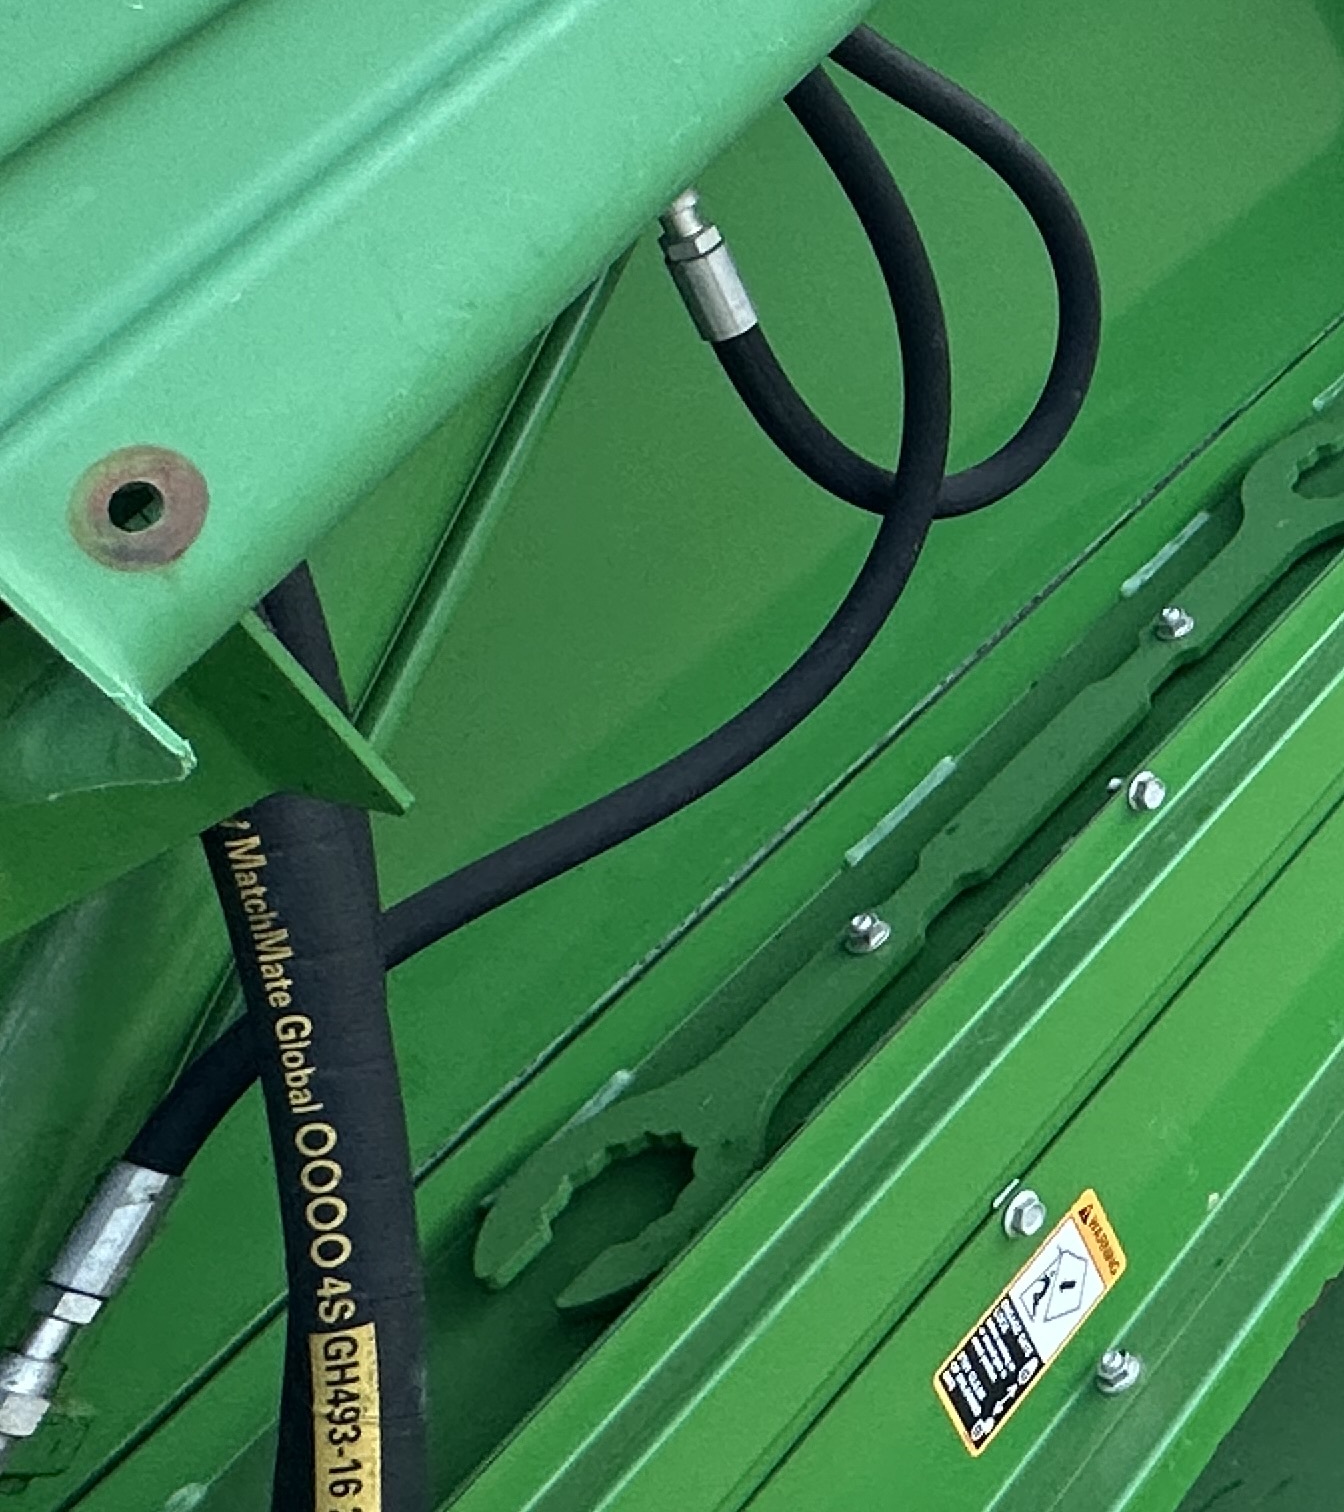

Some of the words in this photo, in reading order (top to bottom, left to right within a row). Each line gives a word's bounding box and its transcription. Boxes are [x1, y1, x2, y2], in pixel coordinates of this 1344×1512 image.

[224, 834, 294, 1008] MatchMate
[275, 1014, 324, 1114] Global
[316, 1276, 357, 1324] 4S
[322, 1335, 364, 1498] GH493-16
